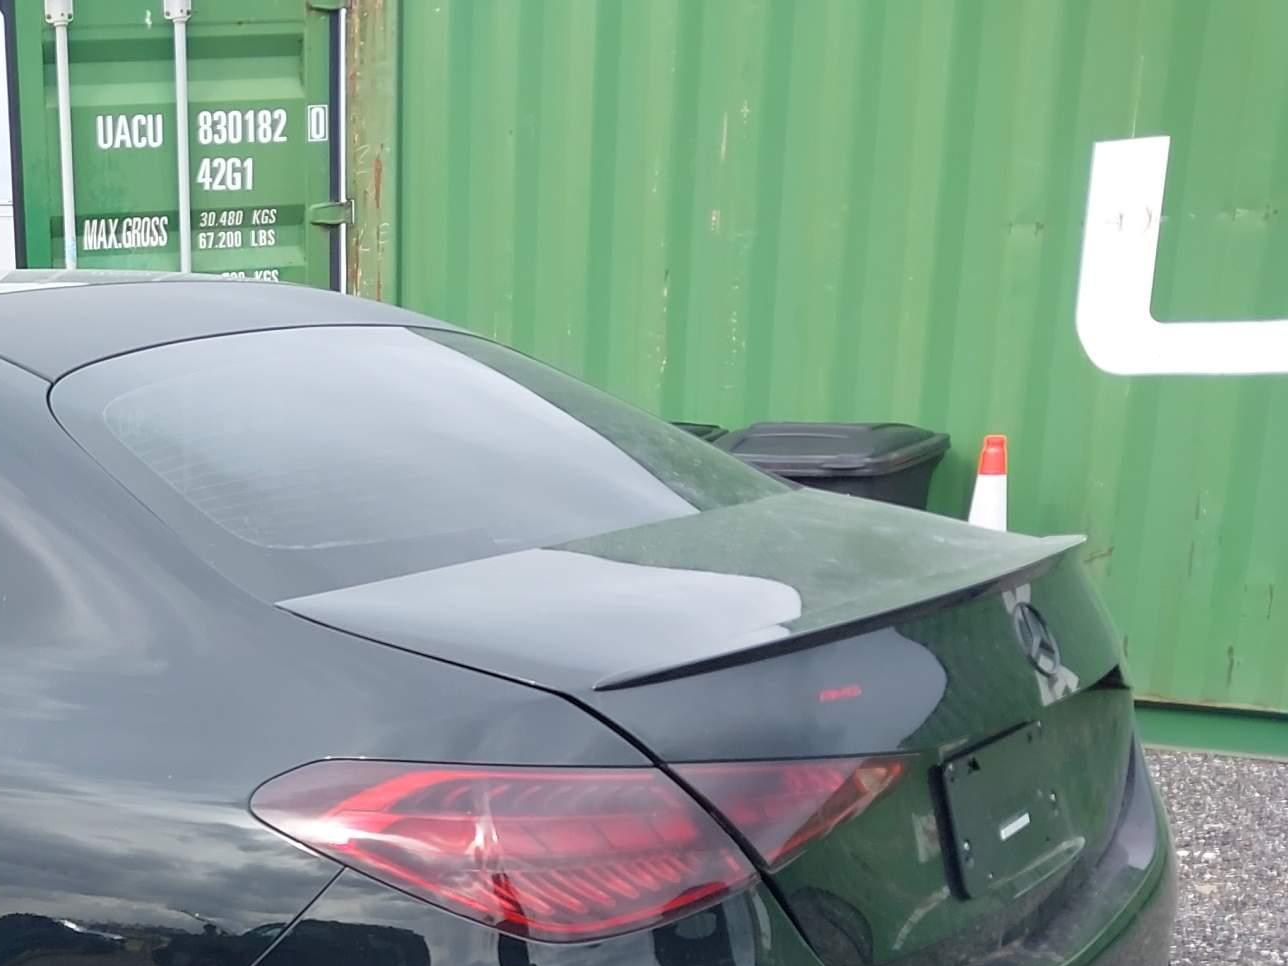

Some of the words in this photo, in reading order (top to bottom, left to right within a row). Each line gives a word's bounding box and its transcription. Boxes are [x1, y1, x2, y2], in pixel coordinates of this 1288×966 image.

[96, 114, 163, 149] UACU
[197, 109, 287, 144] 830182
[311, 107, 325, 140] 0
[197, 157, 253, 190] 42G1
[83, 216, 168, 249] MAX.GROSS
[199, 210, 244, 227] 30.480
[252, 208, 277, 225] KGS
[198, 230, 242, 249] 67.200
[251, 229, 275, 247] LBS
